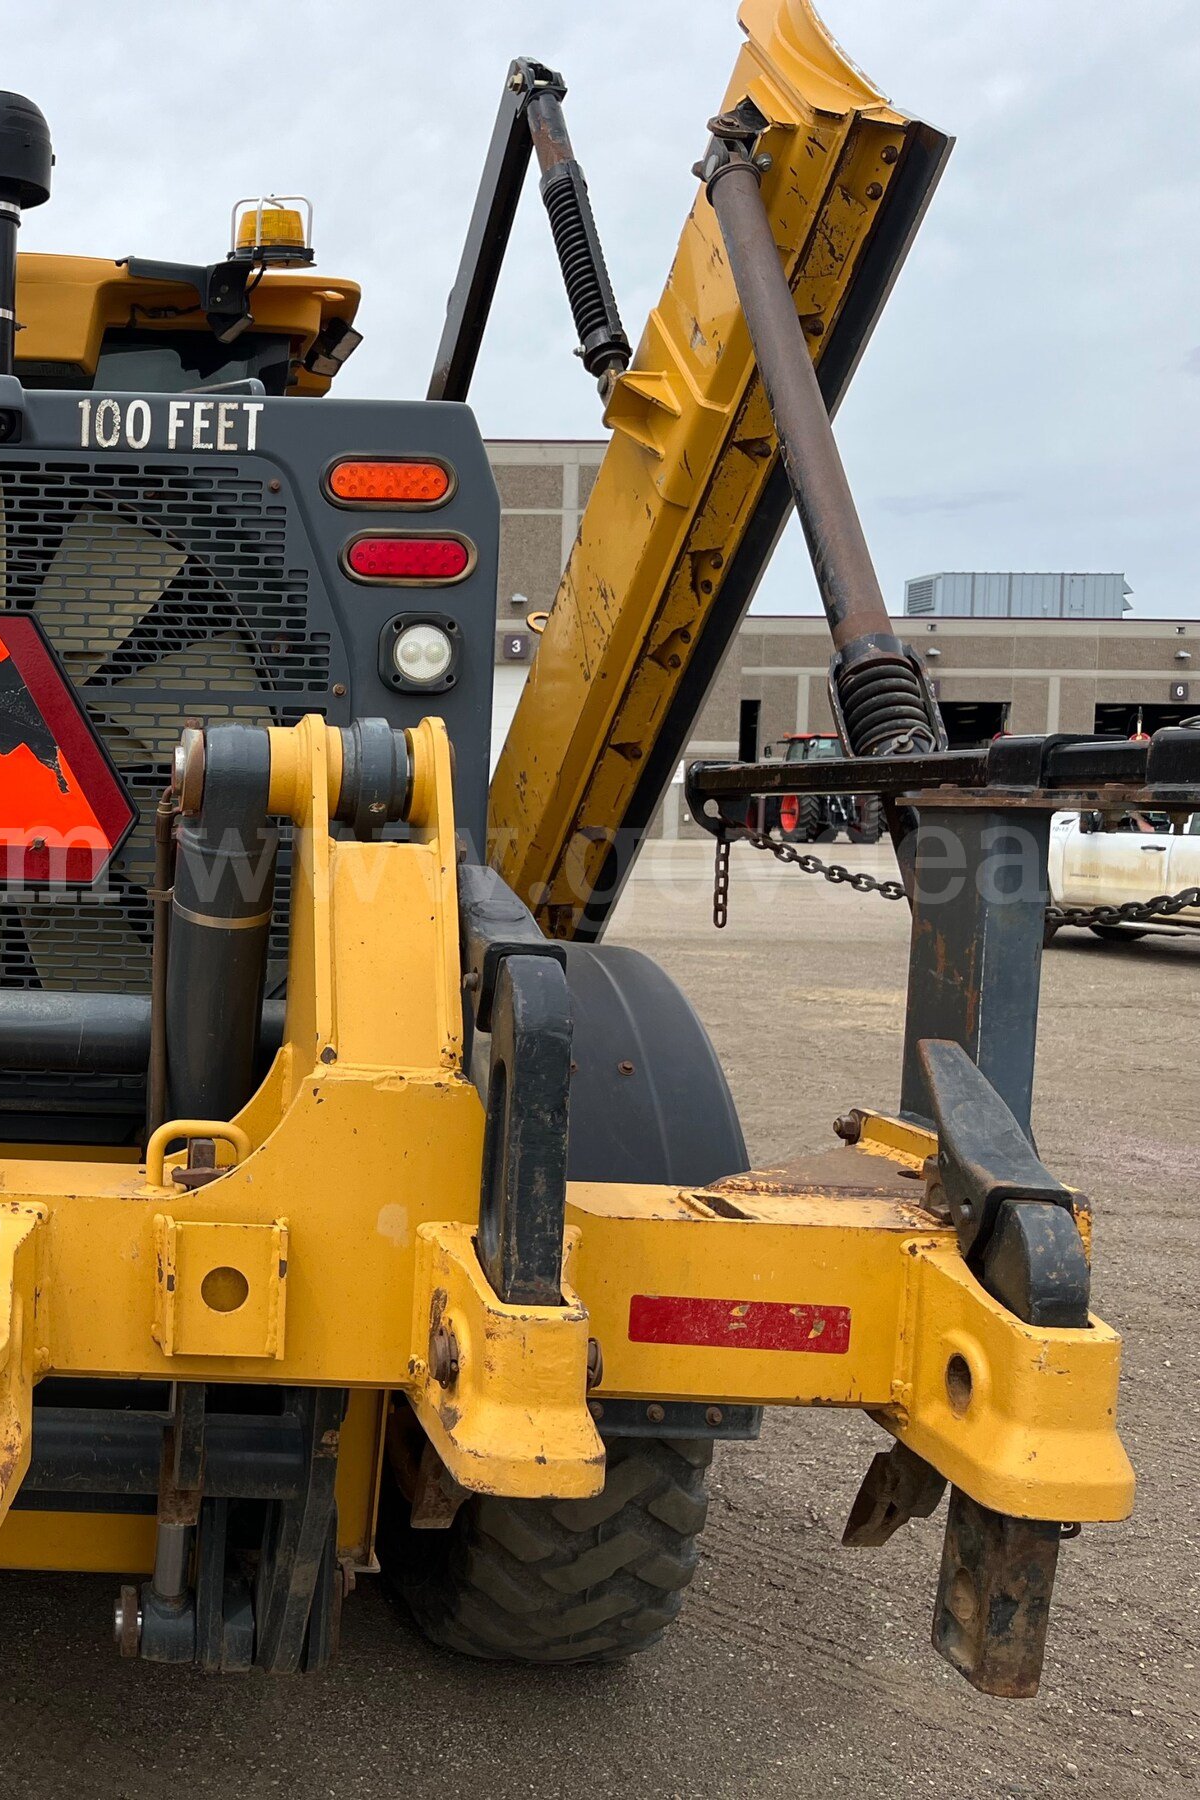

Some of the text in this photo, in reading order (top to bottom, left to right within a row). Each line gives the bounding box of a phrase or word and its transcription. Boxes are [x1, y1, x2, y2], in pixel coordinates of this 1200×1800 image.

[77, 399, 151, 449] 100
[167, 401, 265, 451] FEET
[511, 639, 521, 653] 3
[1176, 685, 1184, 697] 6
